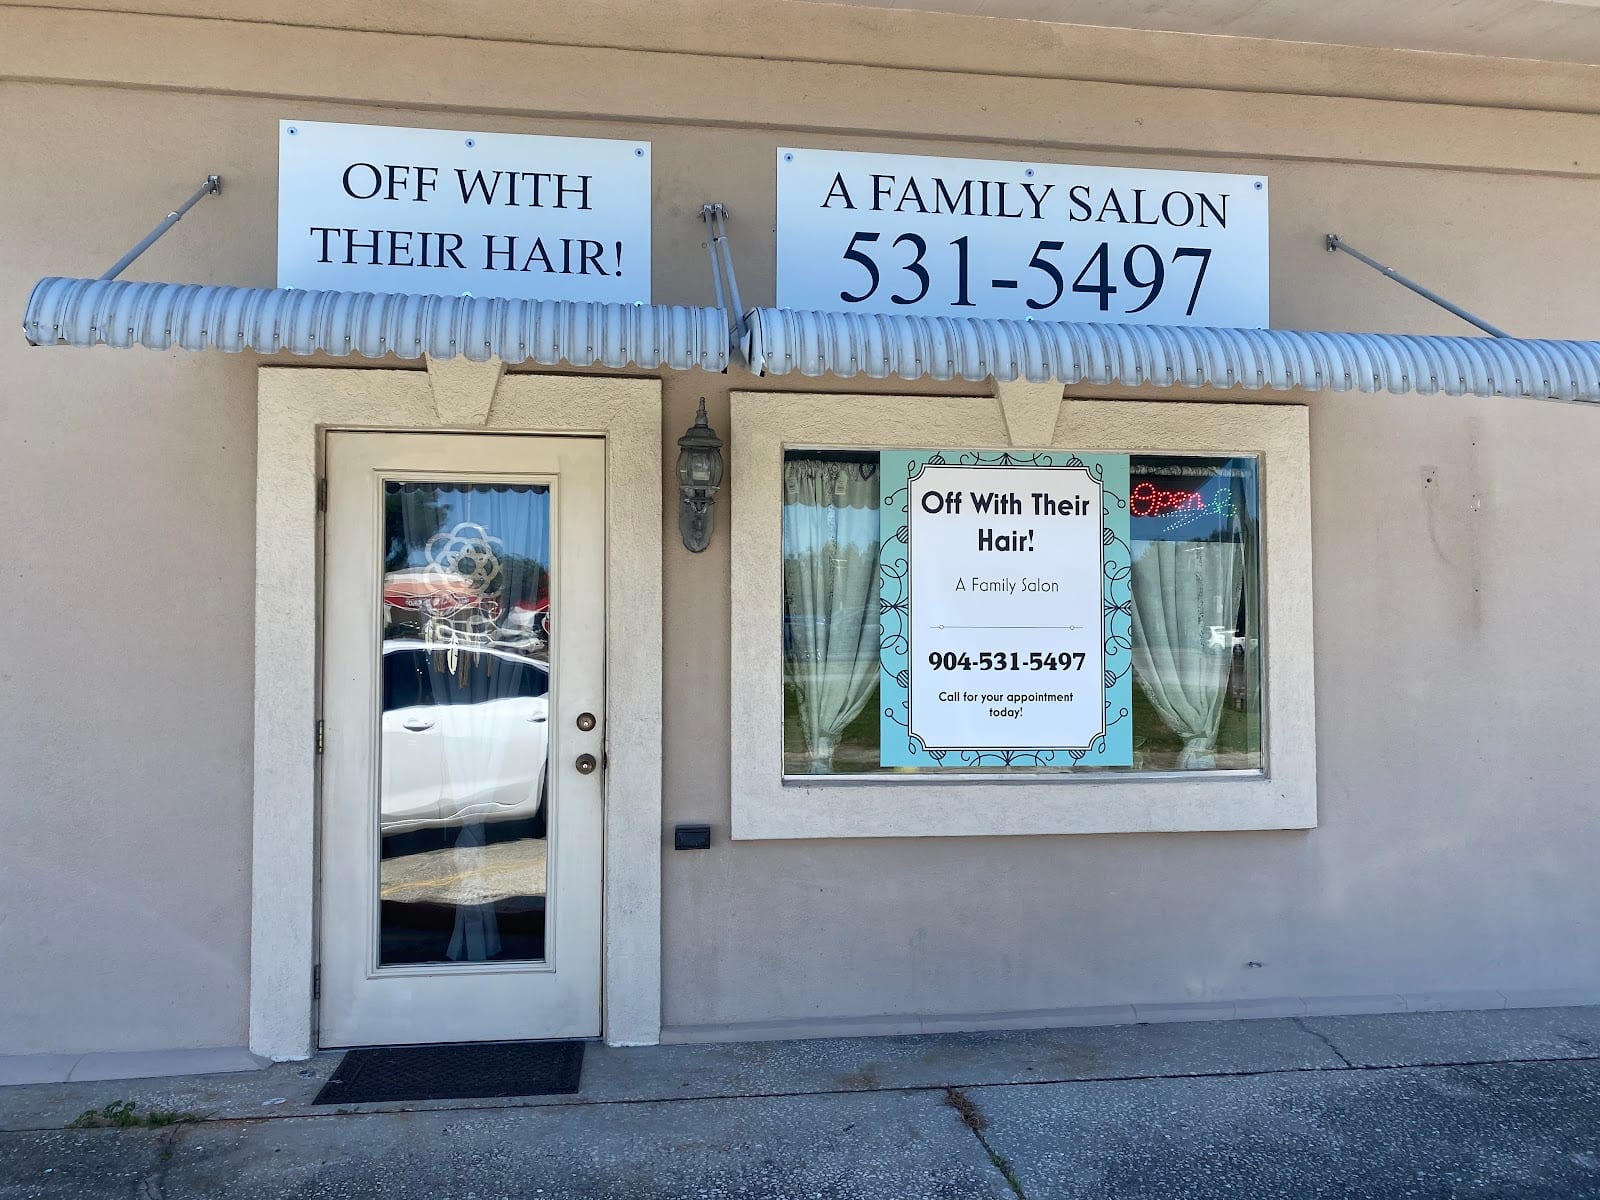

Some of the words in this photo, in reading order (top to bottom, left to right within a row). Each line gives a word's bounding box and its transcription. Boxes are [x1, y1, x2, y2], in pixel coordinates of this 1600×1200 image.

[342, 162, 438, 202] OFF
[453, 168, 593, 210] WITH
[820, 171, 858, 210] A
[868, 174, 1056, 220] FAMILY
[1069, 185, 1231, 229] SALON
[310, 226, 468, 269] THEIR
[481, 234, 622, 278] HAIR!
[840, 231, 1212, 317] 531-5497
[921, 490, 962, 515] Off
[969, 491, 1022, 516] With
[1031, 492, 1090, 517] Their
[1130, 481, 1204, 516] Open
[978, 528, 1034, 553] Hair!
[955, 577, 966, 592] A
[971, 576, 1017, 596] Family
[1021, 577, 1059, 593] Salon
[928, 651, 1086, 671] 904-531-5497
[938, 691, 960, 702] Call
[963, 691, 978, 702] for
[980, 694, 1004, 705] your
[1006, 692, 1074, 705] appointment
[989, 706, 1023, 720] today!
